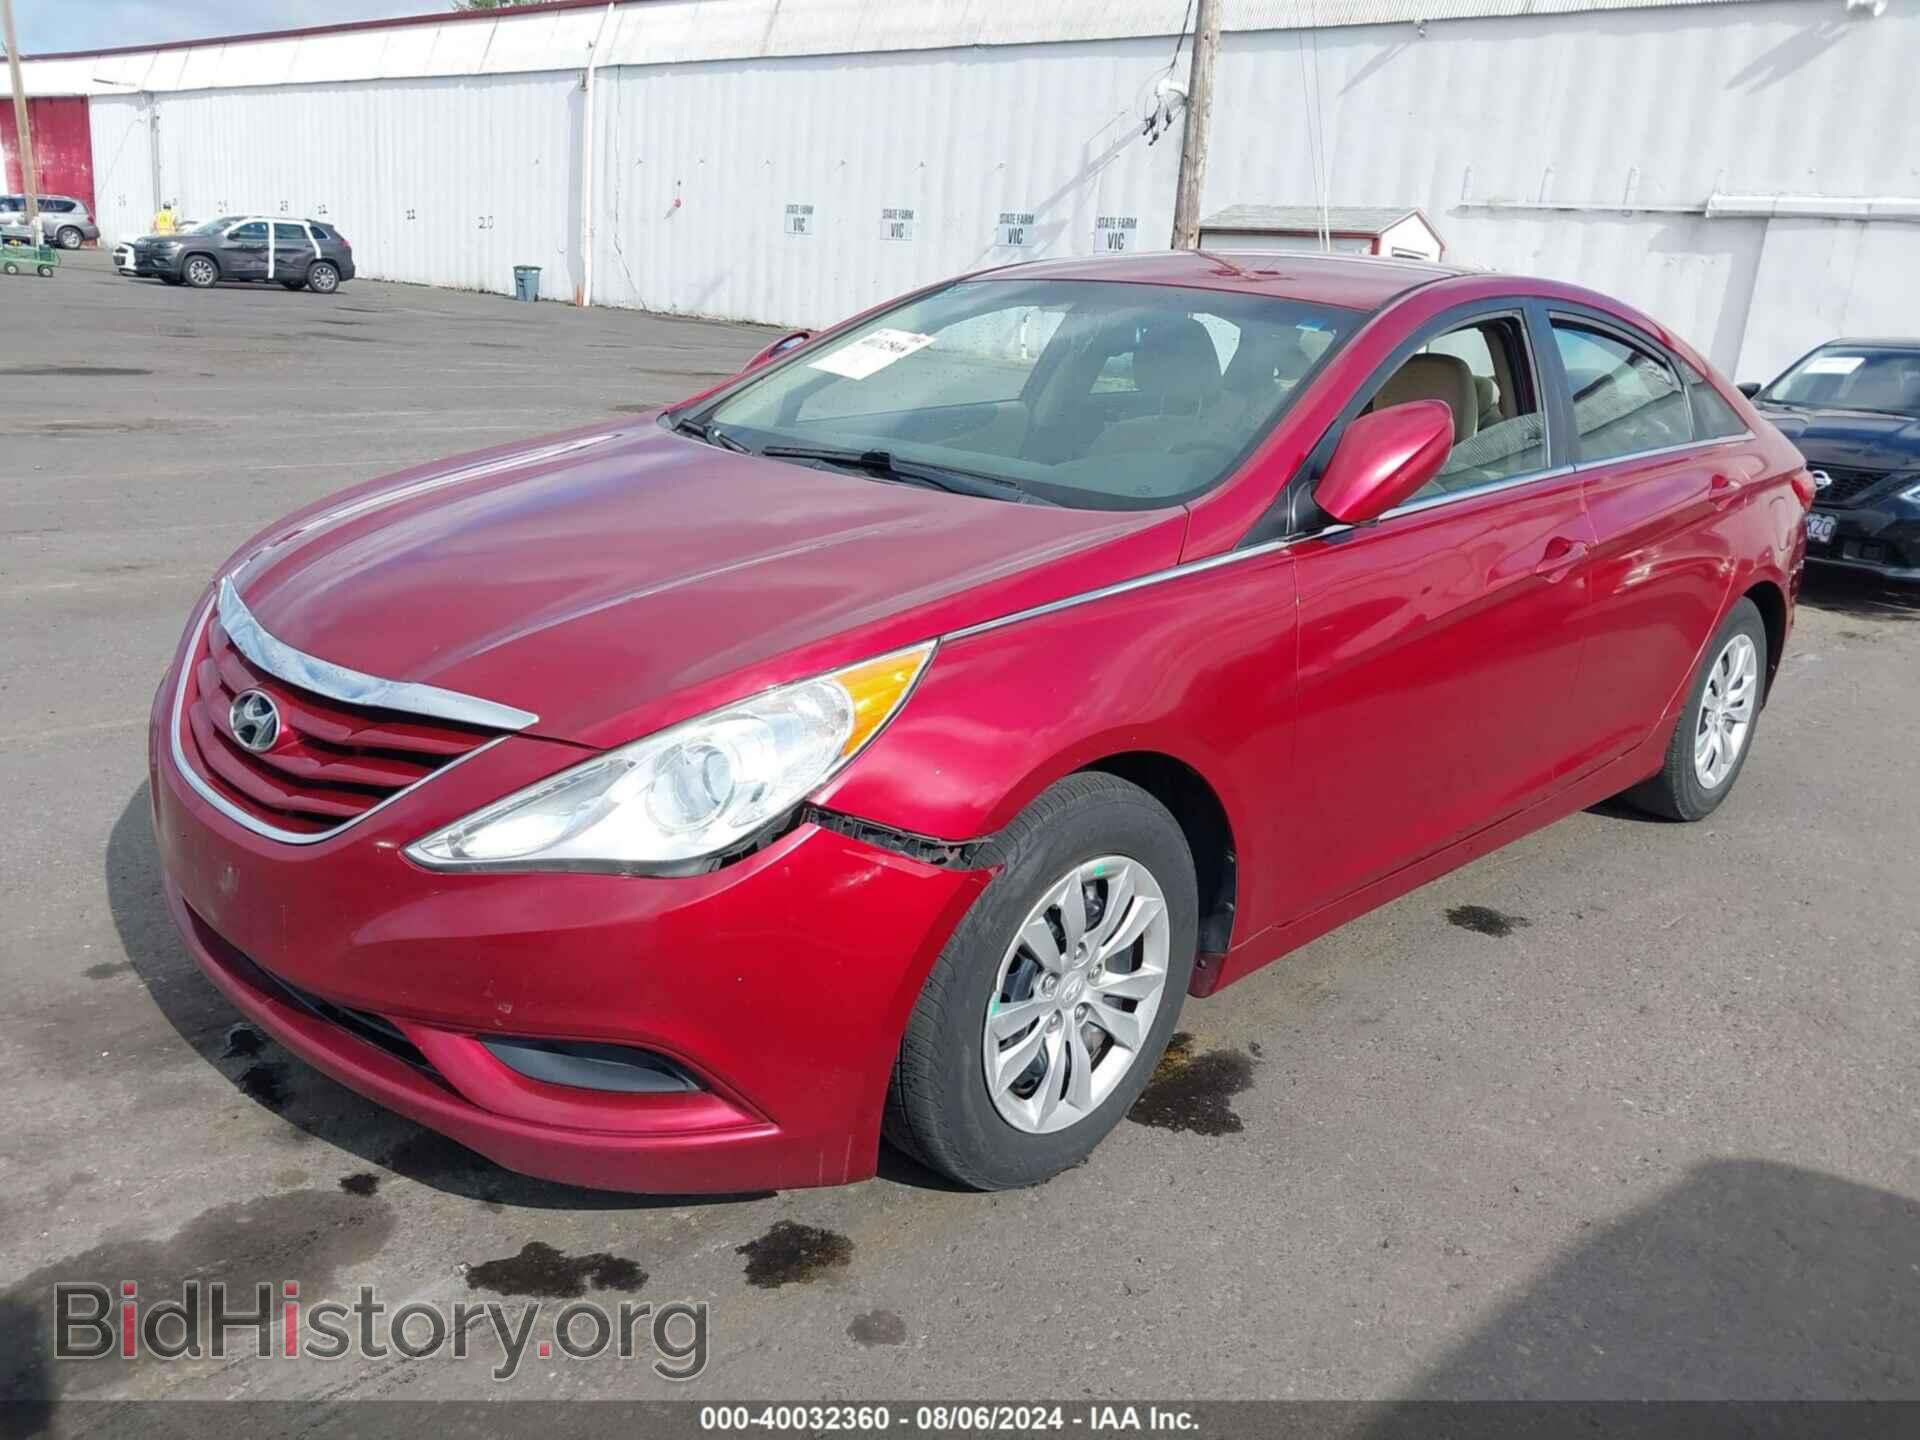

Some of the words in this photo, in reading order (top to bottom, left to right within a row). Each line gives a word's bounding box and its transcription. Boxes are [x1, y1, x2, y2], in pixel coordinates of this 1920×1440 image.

[882, 208, 897, 220] STATE
[899, 209, 914, 220] FARM
[1000, 213, 1015, 225] STATE
[1017, 214, 1034, 225] FARM
[478, 215, 494, 230] 20
[793, 217, 806, 233] VIC
[1097, 217, 1115, 230] STATE
[1117, 217, 1137, 229] FARM
[890, 222, 904, 239] VIC
[1008, 227, 1023, 245] VIC
[1107, 232, 1124, 250] VIC
